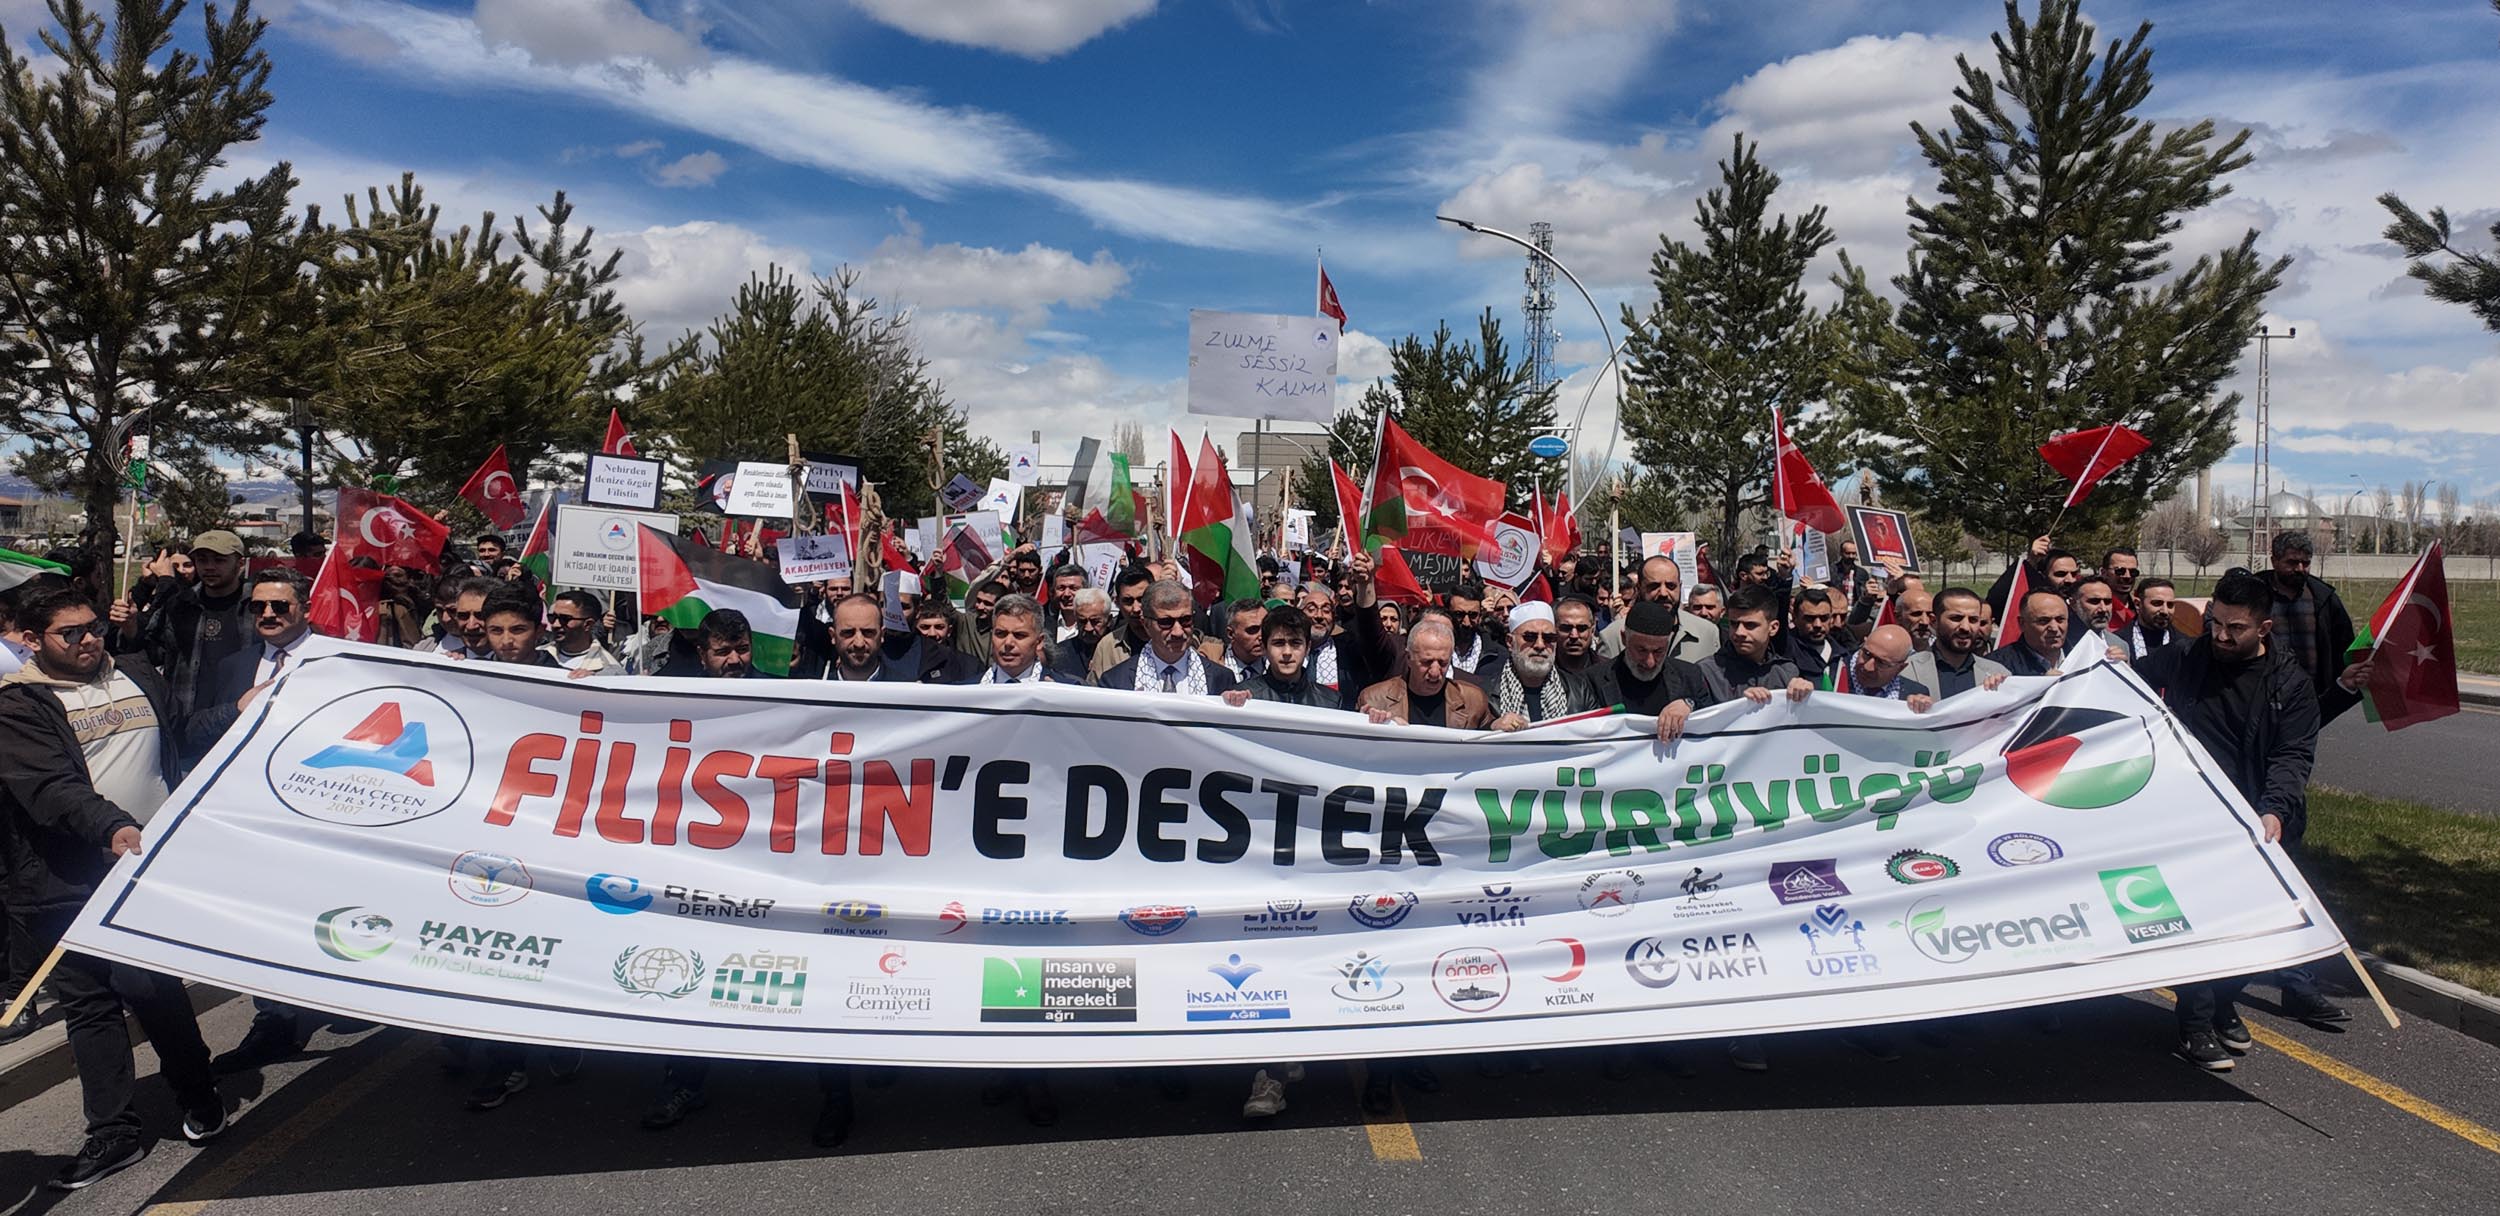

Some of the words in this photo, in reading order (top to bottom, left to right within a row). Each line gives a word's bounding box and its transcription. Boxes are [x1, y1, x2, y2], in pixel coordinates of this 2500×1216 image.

[1205, 331, 1277, 351] ZULME
[1256, 377, 1327, 397] KALMA
[604, 463, 647, 476] Nehirden
[595, 475, 624, 486] denize
[627, 478, 653, 489] özgür
[607, 487, 639, 499] Filistin
[564, 560, 596, 571] İKTİSADİ
[598, 564, 607, 572] VE
[609, 564, 630, 574] İDARİ
[785, 562, 847, 576] AKADEMİSYEN
[592, 574, 633, 585] FAKÜLTESİ
[72, 715, 105, 733] OUTH
[124, 706, 152, 720] BLUE
[344, 774, 385, 788] AĞRI
[288, 772, 365, 797] İBRAHİM
[369, 789, 427, 808] ÇEÇEN
[326, 802, 365, 816] 2007
[1062, 764, 1447, 867] DESTEK
[420, 920, 562, 955] HAYRAT
[2129, 920, 2186, 941] YEŞİLAY
[1682, 932, 1760, 959] SAFA
[419, 937, 550, 969] YARDIM
[721, 949, 808, 971] AĞRI
[1097, 963, 1116, 973] ve
[1687, 955, 1769, 981] VAKFI
[1045, 975, 1131, 992] medeniyet
[883, 985, 931, 998] Yayma
[1187, 989, 1236, 1003] İNSAN
[1241, 990, 1287, 1001] VAKFI
[846, 995, 931, 1014] Cemiyeti
[1045, 992, 1117, 1007] hareketi
[1545, 993, 1595, 1007] KIZILAY
[1045, 1010, 1074, 1022] ağrı
[1229, 1010, 1260, 1019] AĞRI
